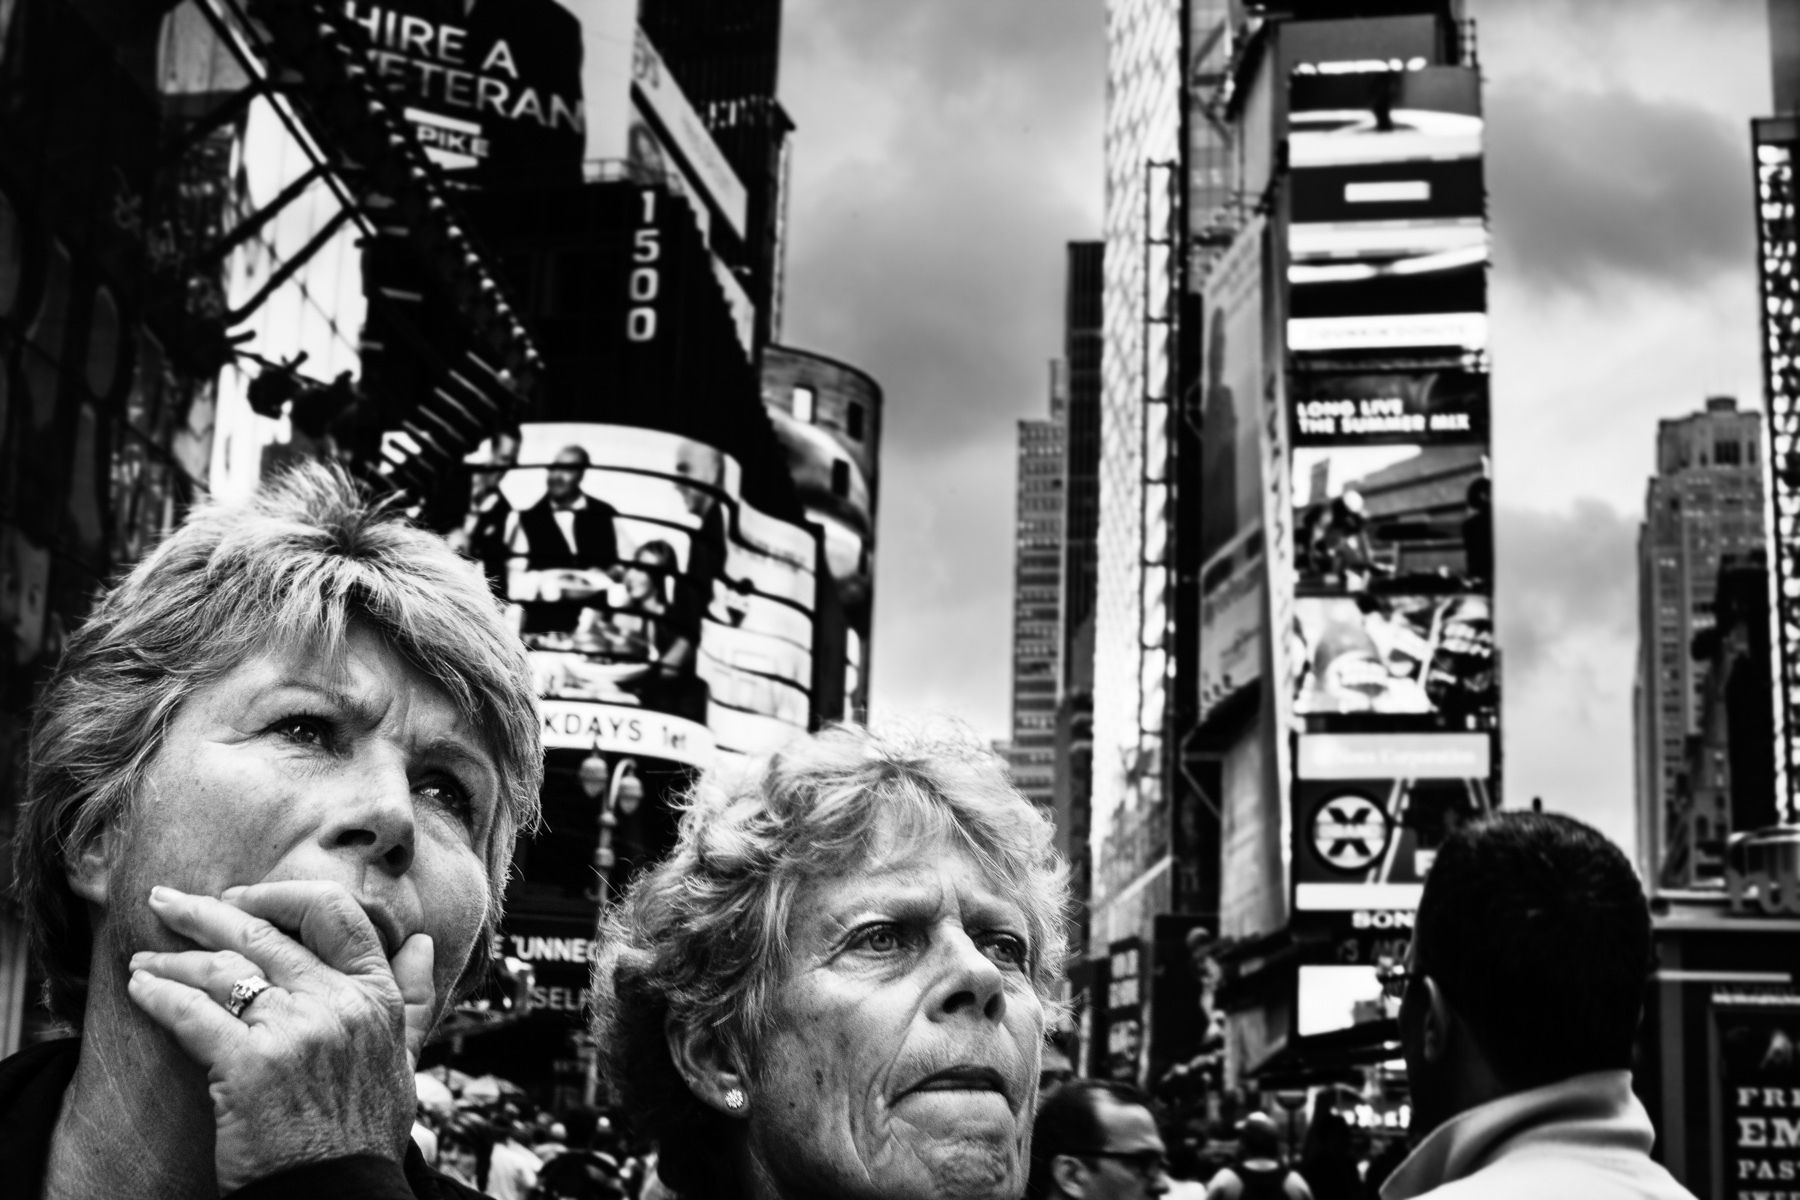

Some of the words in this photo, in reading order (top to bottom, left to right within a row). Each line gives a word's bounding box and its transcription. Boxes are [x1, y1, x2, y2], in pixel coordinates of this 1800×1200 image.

[345, 0, 467, 64] HIRE
[481, 39, 519, 79] A
[366, 49, 584, 134] ETERAN
[417, 125, 489, 157] PIKE
[627, 190, 661, 341] 1500
[1360, 398, 1403, 416] LIVE
[1298, 416, 1335, 434] THE
[544, 713, 642, 742] KDAYS
[1352, 911, 1414, 929] SON
[1737, 1159, 1800, 1181] PAS
